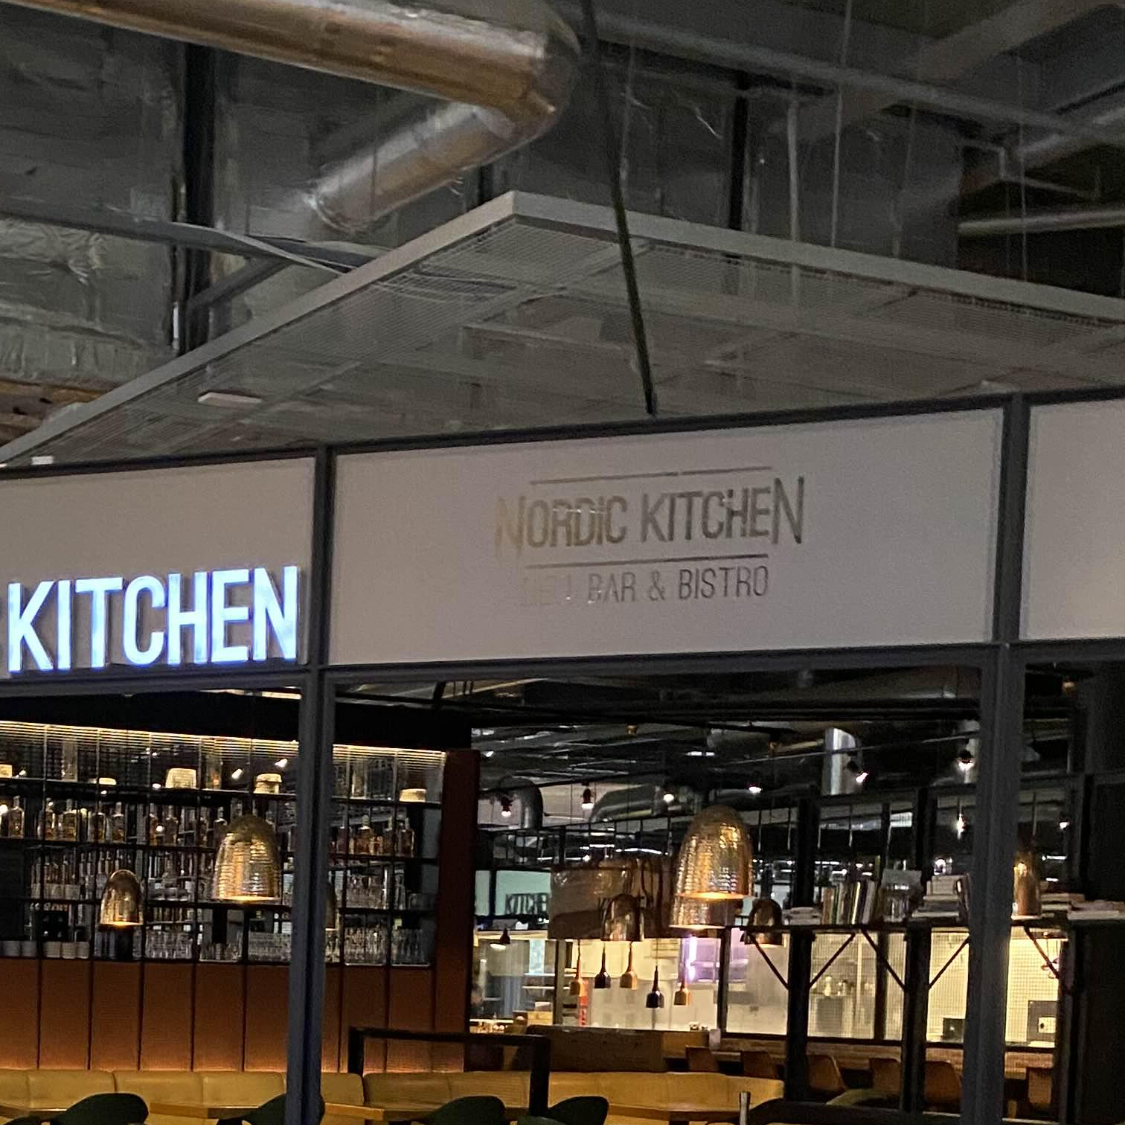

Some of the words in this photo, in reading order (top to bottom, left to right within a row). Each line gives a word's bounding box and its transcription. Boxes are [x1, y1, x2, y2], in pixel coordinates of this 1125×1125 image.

[493, 494, 627, 561] NORDIC
[640, 475, 805, 545] KITCHEN
[7, 564, 301, 673] KITCHEN
[587, 571, 637, 603] BAR
[647, 570, 666, 601] &
[677, 565, 769, 600] BISTRO
